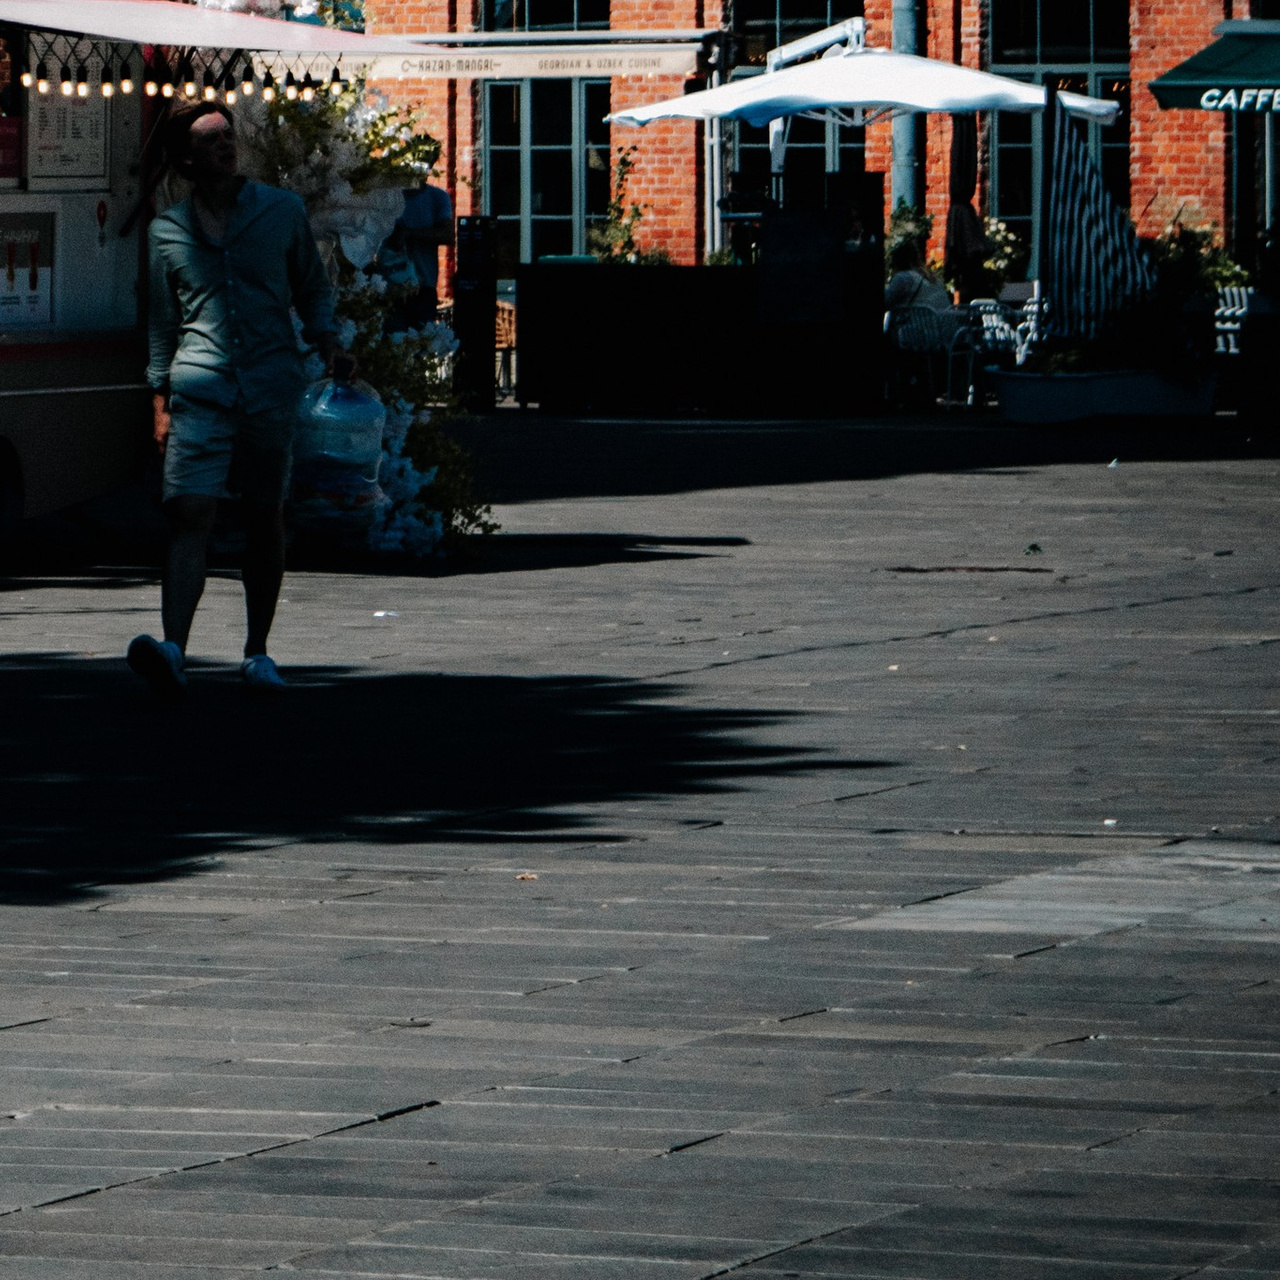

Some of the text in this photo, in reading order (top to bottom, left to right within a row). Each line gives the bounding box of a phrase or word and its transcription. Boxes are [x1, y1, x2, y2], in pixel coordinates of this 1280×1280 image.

[538, 60, 581, 70] GEORGIAN
[597, 58, 623, 69] UZBEK
[628, 58, 661, 68] CUISINE
